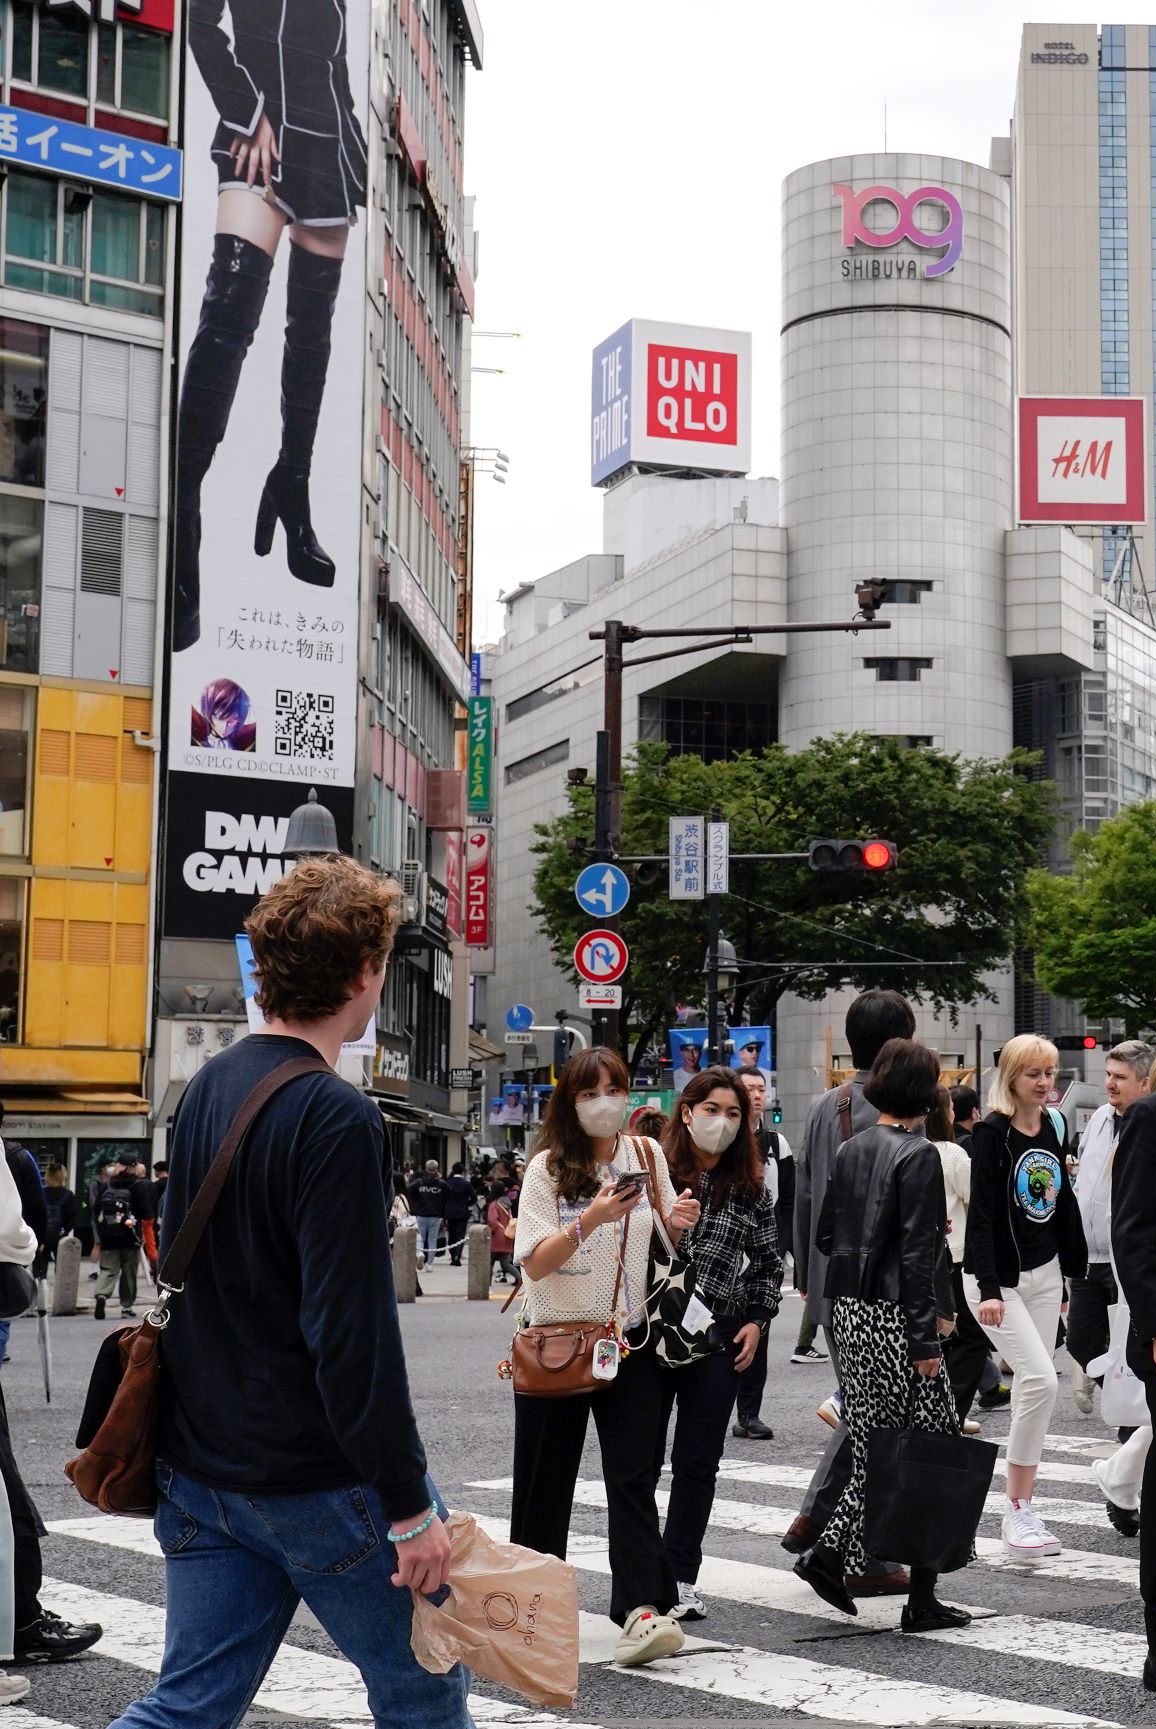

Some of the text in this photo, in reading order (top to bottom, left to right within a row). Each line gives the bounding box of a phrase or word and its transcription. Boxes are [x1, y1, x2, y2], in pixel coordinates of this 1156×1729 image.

[1031, 52, 1089, 65] INDIGO
[1044, 42, 1075, 50] HOTEL
[832, 182, 963, 278] 109
[842, 259, 917, 278] SHIBUYA
[602, 346, 622, 406] THE
[658, 356, 722, 394] UNI
[593, 395, 629, 466] PRIME
[657, 396, 728, 434] QLO
[1051, 439, 1113, 480] H&M
[238, 607, 345, 634] これは、きみの
[217, 626, 345, 664] 「失われた物語」
[674, 834, 683, 866] Shibuya
[684, 824, 699, 892] 渋谷駅前
[713, 826, 723, 891] スクランブル式
[469, 875, 486, 921] アコム
[470, 926, 483, 934] 3F
[433, 948, 453, 1000] LUSH
[604, 988, 615, 997] 20
[517, 1592, 543, 1646] ohana
